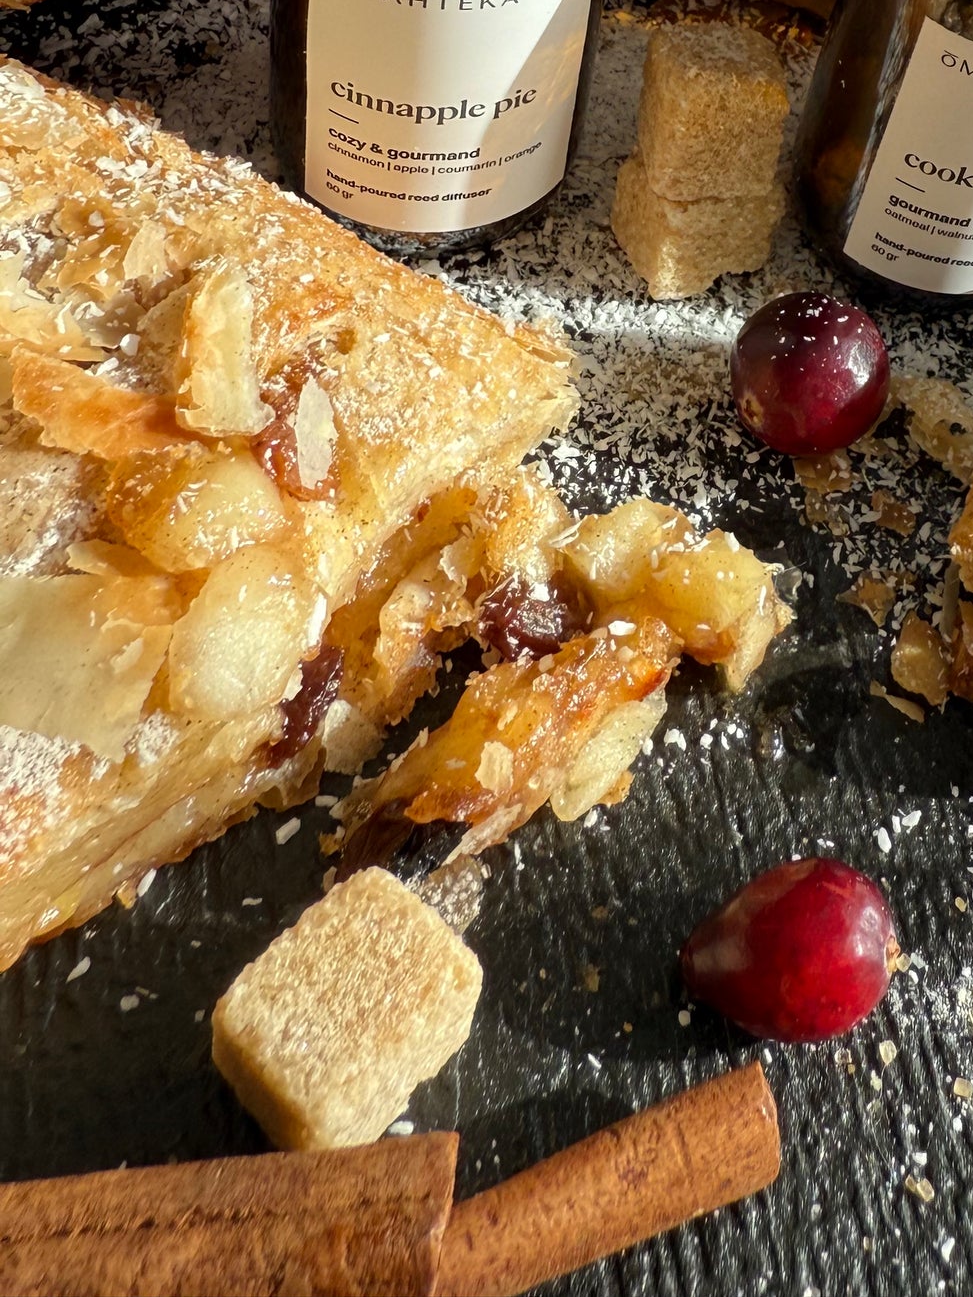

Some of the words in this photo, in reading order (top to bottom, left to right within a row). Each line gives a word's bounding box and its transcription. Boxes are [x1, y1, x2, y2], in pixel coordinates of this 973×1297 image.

[330, 81, 486, 125] cinnapple
[492, 87, 537, 120] pie
[328, 127, 367, 151] cozy
[370, 143, 383, 155] &
[387, 147, 481, 161] gourmand
[328, 142, 385, 168] cinnamon
[437, 160, 497, 174] coumarin
[504, 141, 542, 162] orange
[326, 168, 406, 200] hand-poured
[441, 188, 493, 202] diffuser
[342, 190, 354, 200] gr
[888, 194, 972, 227] gourmand
[875, 231, 951, 265] hand-poured
[886, 252, 899, 261] gr
